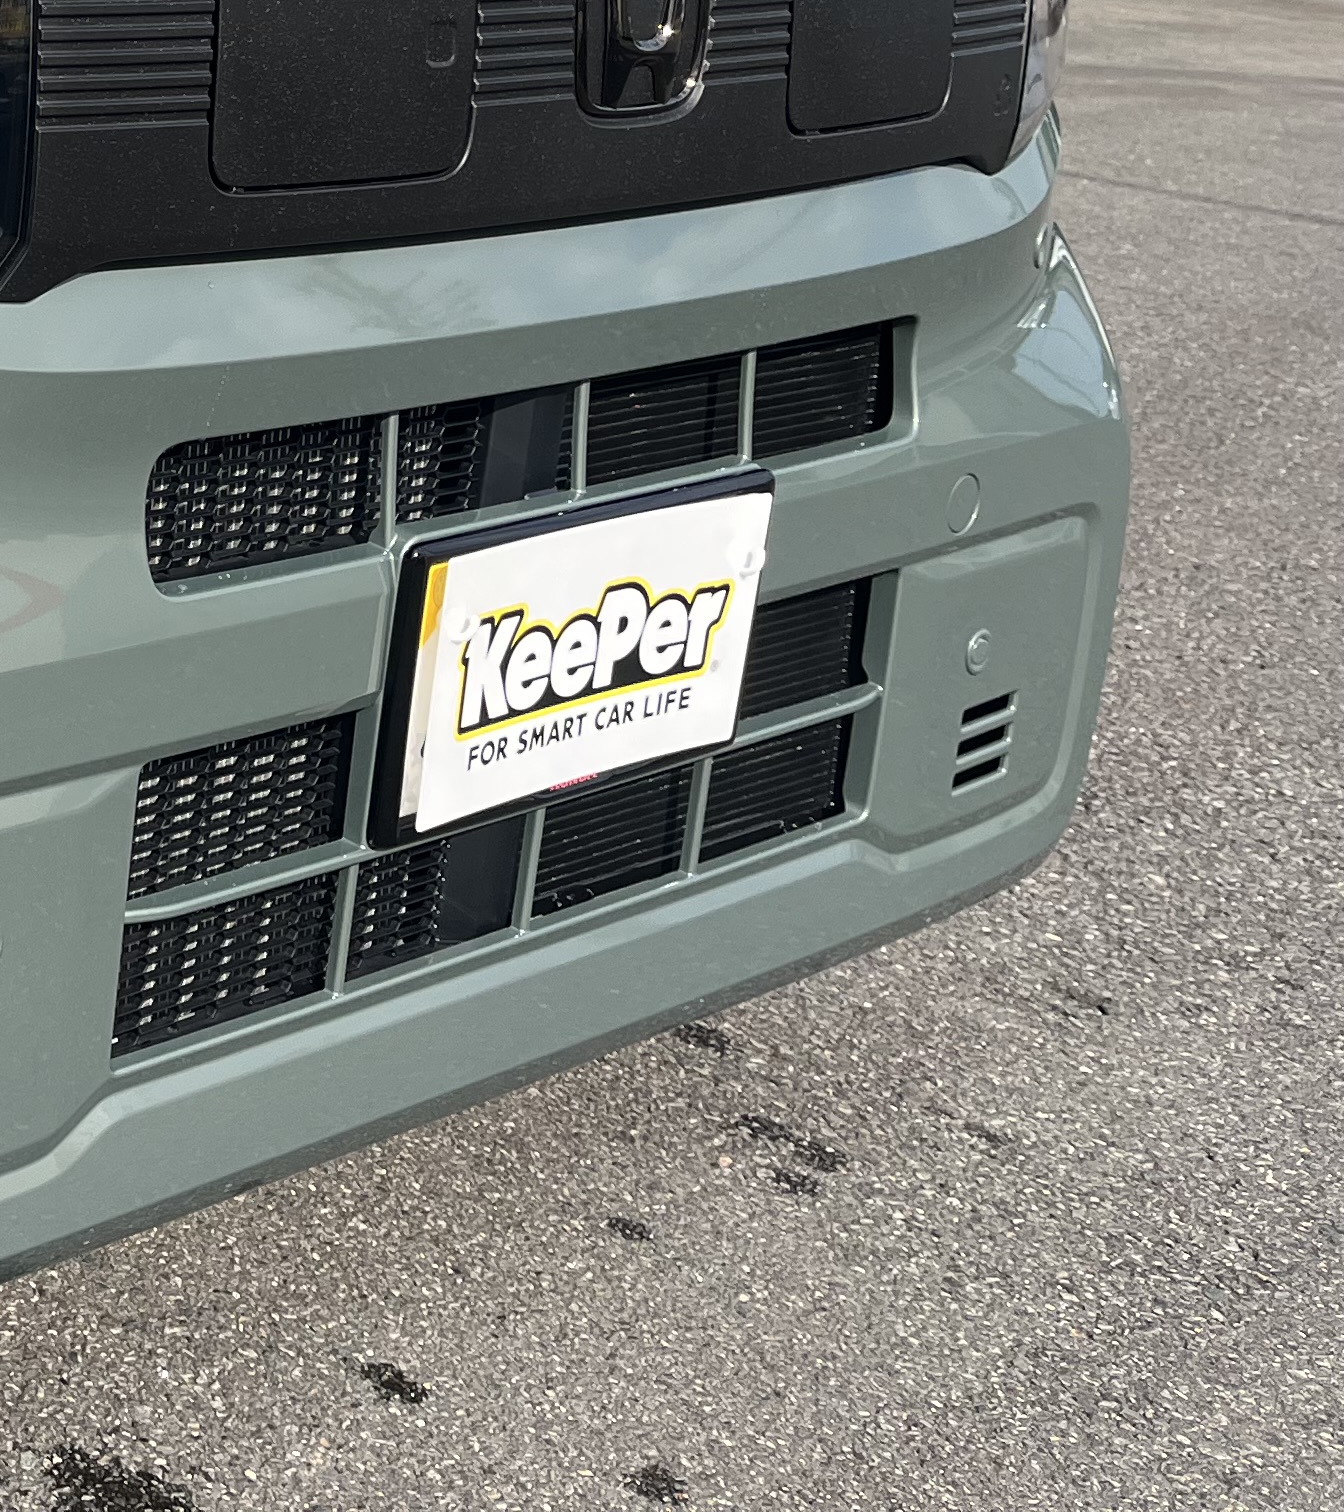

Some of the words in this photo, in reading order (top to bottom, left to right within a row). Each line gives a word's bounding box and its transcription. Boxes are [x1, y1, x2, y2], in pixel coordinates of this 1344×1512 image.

[457, 580, 732, 737] KeePer
[466, 740, 509, 772] FOR
[516, 712, 588, 756] SMART
[594, 699, 635, 731] CAR
[643, 687, 693, 719] LIFE
